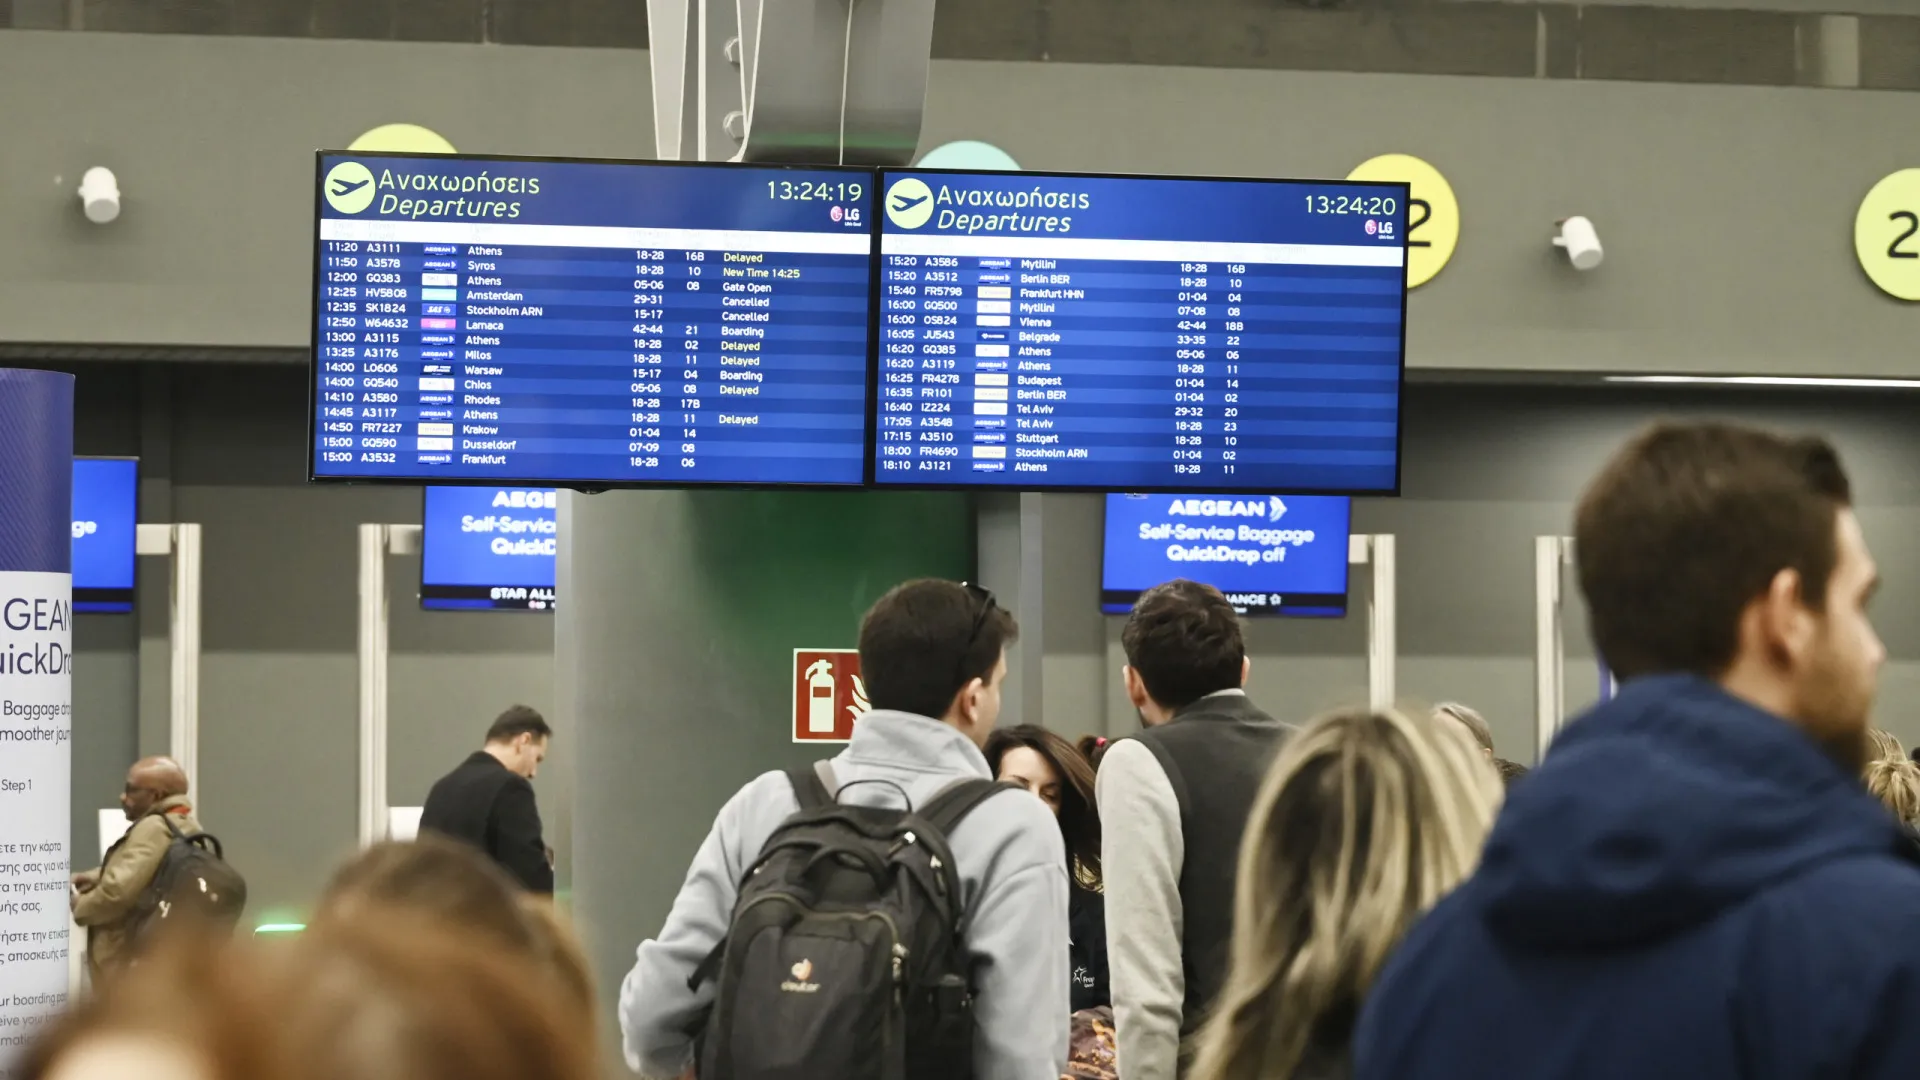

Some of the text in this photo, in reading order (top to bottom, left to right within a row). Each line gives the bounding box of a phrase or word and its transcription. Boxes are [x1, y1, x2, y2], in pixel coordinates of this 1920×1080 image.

[378, 169, 540, 195] Αναχωρήσεις
[767, 180, 862, 202] 13:24:19
[936, 185, 1090, 209] Αναχωρήσεις
[379, 194, 521, 219] Departures
[1305, 195, 1396, 216] 13:24:20
[844, 207, 860, 221] LG
[937, 209, 1072, 234] Departures
[1378, 221, 1393, 234] LG
[1887, 211, 1919, 258] 2
[328, 242, 763, 264] 11:20 A3111 Athens Delayed
[328, 256, 801, 278] 11:50 A3578 Syros New Time 14:25
[889, 256, 1056, 271] 15:20 A3586 Mytilini
[328, 272, 772, 294] 12:00 GQ383 Athens Gate Open
[888, 270, 1071, 285] 15:20 A3512 Berlin BER
[327, 286, 770, 307] 12:25 HV5808 Amsterdam Cancelled
[888, 285, 1084, 299] 15:40 FR5798 Frankfurt HHN
[327, 302, 769, 322] 12:35 SK1824 Stockholm ARN Cancelled
[888, 300, 1055, 314] 16:00 GQ500 Mytilini
[326, 317, 764, 339] 12:50 W64632 Boarding
[887, 314, 1052, 327] 16:00 Vienna
[326, 332, 760, 352] 13:00 A3115 Athens Delayed
[887, 329, 1061, 344] 16:05 JU543 Belgrade
[326, 347, 760, 367] 13:25 A3176 Milos Delayed
[886, 344, 1052, 356] 16:20 GQ385 Athens
[886, 358, 1052, 371] 16:20 A3119 Athens
[325, 362, 763, 383] 14:00 Warsaw Boarding
[886, 373, 1062, 387] 16:25 FR4278 Budapest
[325, 376, 759, 396] 14:00 GQ540 Chios Delayed
[885, 387, 1067, 400] 16:35 FR101 Berlin BER
[324, 392, 501, 405] 14:10 A3580 Rhodes
[884, 402, 1054, 414] 16:40 IZ224 Tel Aviv
[324, 407, 759, 426] 14:45 A3117 Athens Delayed
[884, 416, 1054, 429] 17:05 A3548 Tel Aviv
[323, 422, 499, 435] 14:50 FR7227 Krakow
[323, 437, 517, 450] 15:00 GQ590 Dusseldorf
[884, 431, 1059, 445] 17:15 A3510 Stuttgart
[323, 452, 506, 464] 15:00 A3532 Frankfurt
[883, 446, 1088, 458] 18:00 FR4690 Stockholm ARN
[883, 460, 1048, 472] 18:10 A3121 Athens
[1168, 499, 1266, 517] AEGEAN
[1139, 523, 1315, 546] Self-Service Baggage
[1167, 544, 1287, 565] QuickDrop off
[490, 587, 527, 600] STAR
[3, 699, 60, 721] Baggage
[1, 779, 26, 794] Step
[19, 843, 37, 856] την
[23, 862, 42, 875] σας
[13, 882, 31, 895] την
[0, 930, 28, 946] ήστε
[32, 931, 46, 944] την
[13, 992, 55, 1007] boarding
